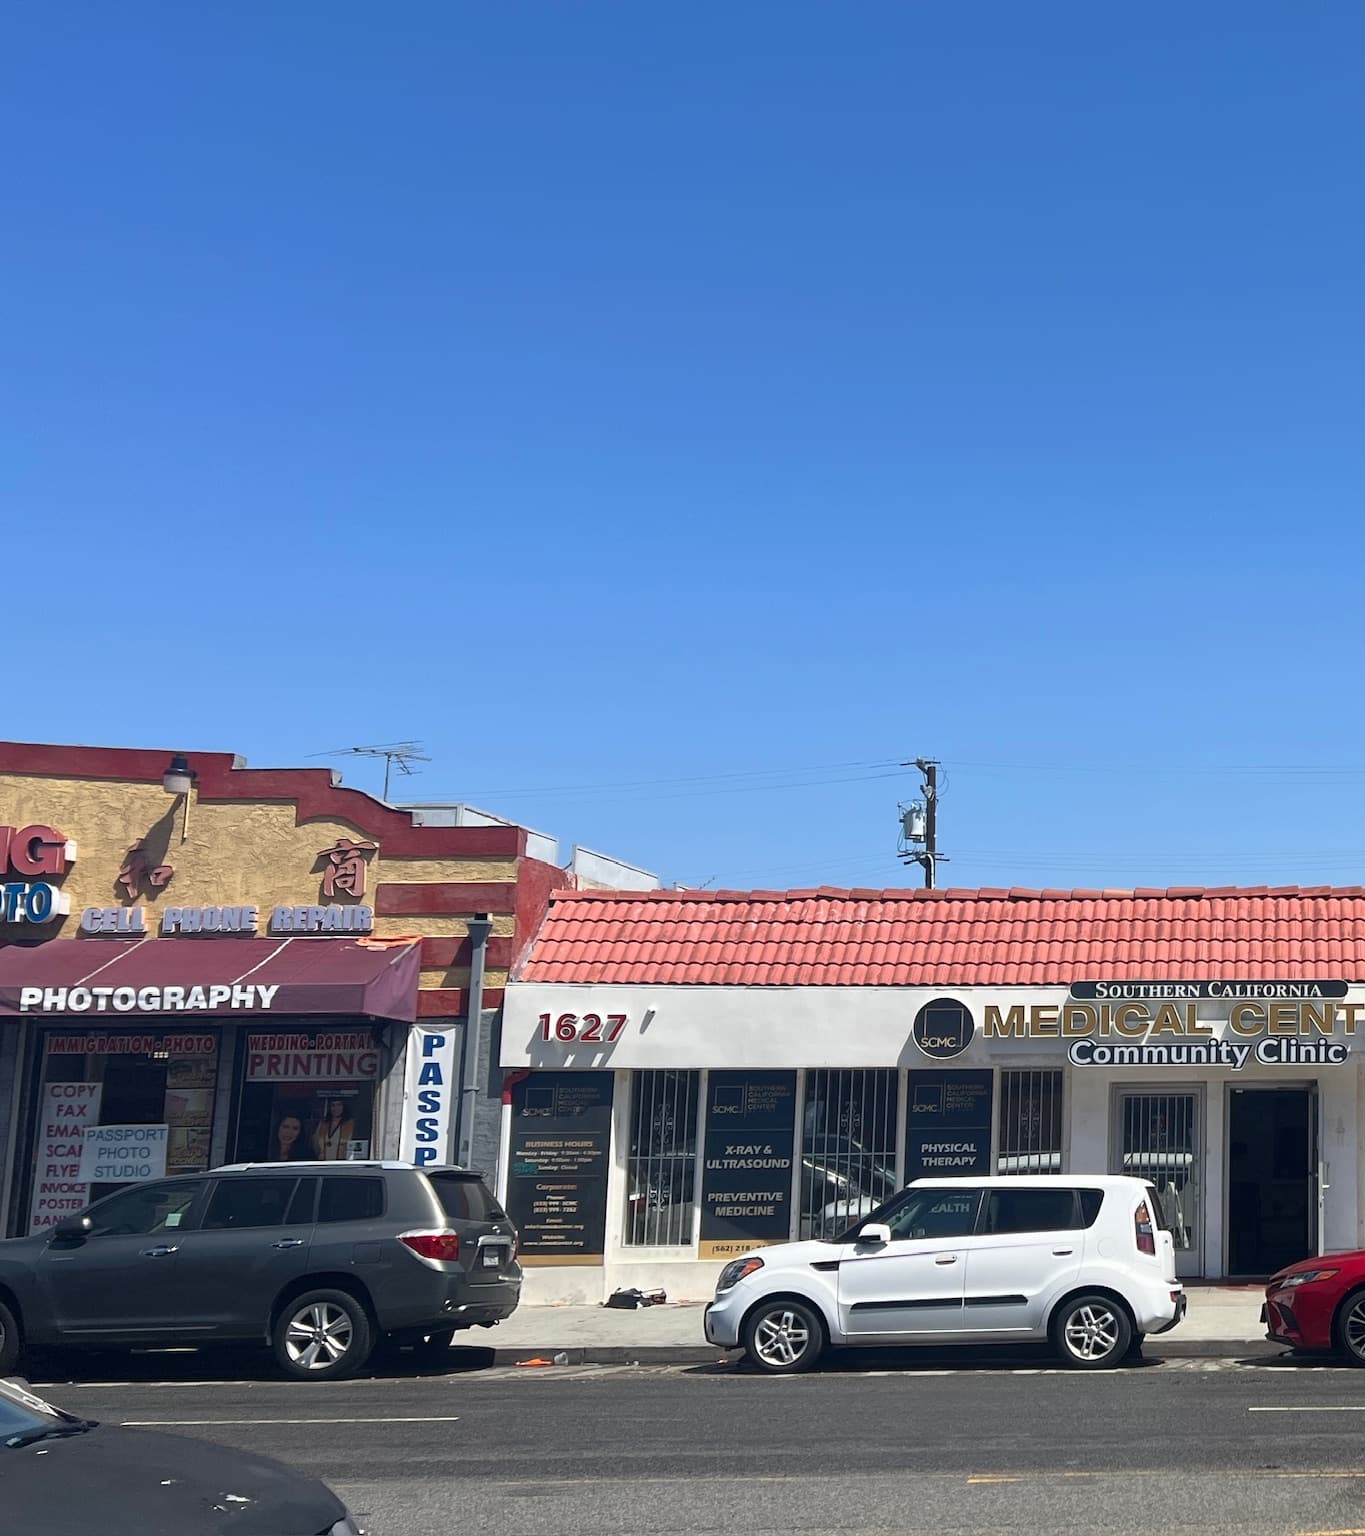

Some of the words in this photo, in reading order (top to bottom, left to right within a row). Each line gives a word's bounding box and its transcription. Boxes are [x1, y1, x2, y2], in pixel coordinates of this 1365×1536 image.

[81, 906, 147, 933] CELL
[162, 905, 258, 933] PHONE
[271, 904, 374, 932] REPAIR
[1095, 982, 1200, 998] SOUTHERN
[1208, 981, 1323, 997] CALIFORNIA
[20, 984, 280, 1011] PHOTOGRAPHY
[983, 1002, 1213, 1038] MEDICAL
[539, 1013, 628, 1042] 1627
[920, 1036, 957, 1048] SCMC
[1071, 1038, 1249, 1068] Community
[1257, 1037, 1343, 1063] Clinic
[249, 1053, 378, 1076] PRINTING
[51, 1085, 97, 1098] COPY
[56, 1104, 88, 1117] FAX
[712, 1105, 738, 1113] SCMC
[86, 1128, 168, 1142] PASSPORT
[97, 1147, 151, 1159] PHOTO
[725, 1145, 762, 1155] X-RAY
[763, 1145, 772, 1154] &
[921, 1143, 977, 1153] PHYSICAL
[706, 1158, 790, 1169] ULTRASOUND
[921, 1156, 977, 1166] THERAPY
[94, 1165, 151, 1178] STUDIO
[40, 1183, 87, 1193] INVOICE
[708, 1192, 784, 1202] PREVENTIVE
[715, 1206, 775, 1216] MEDICINE
